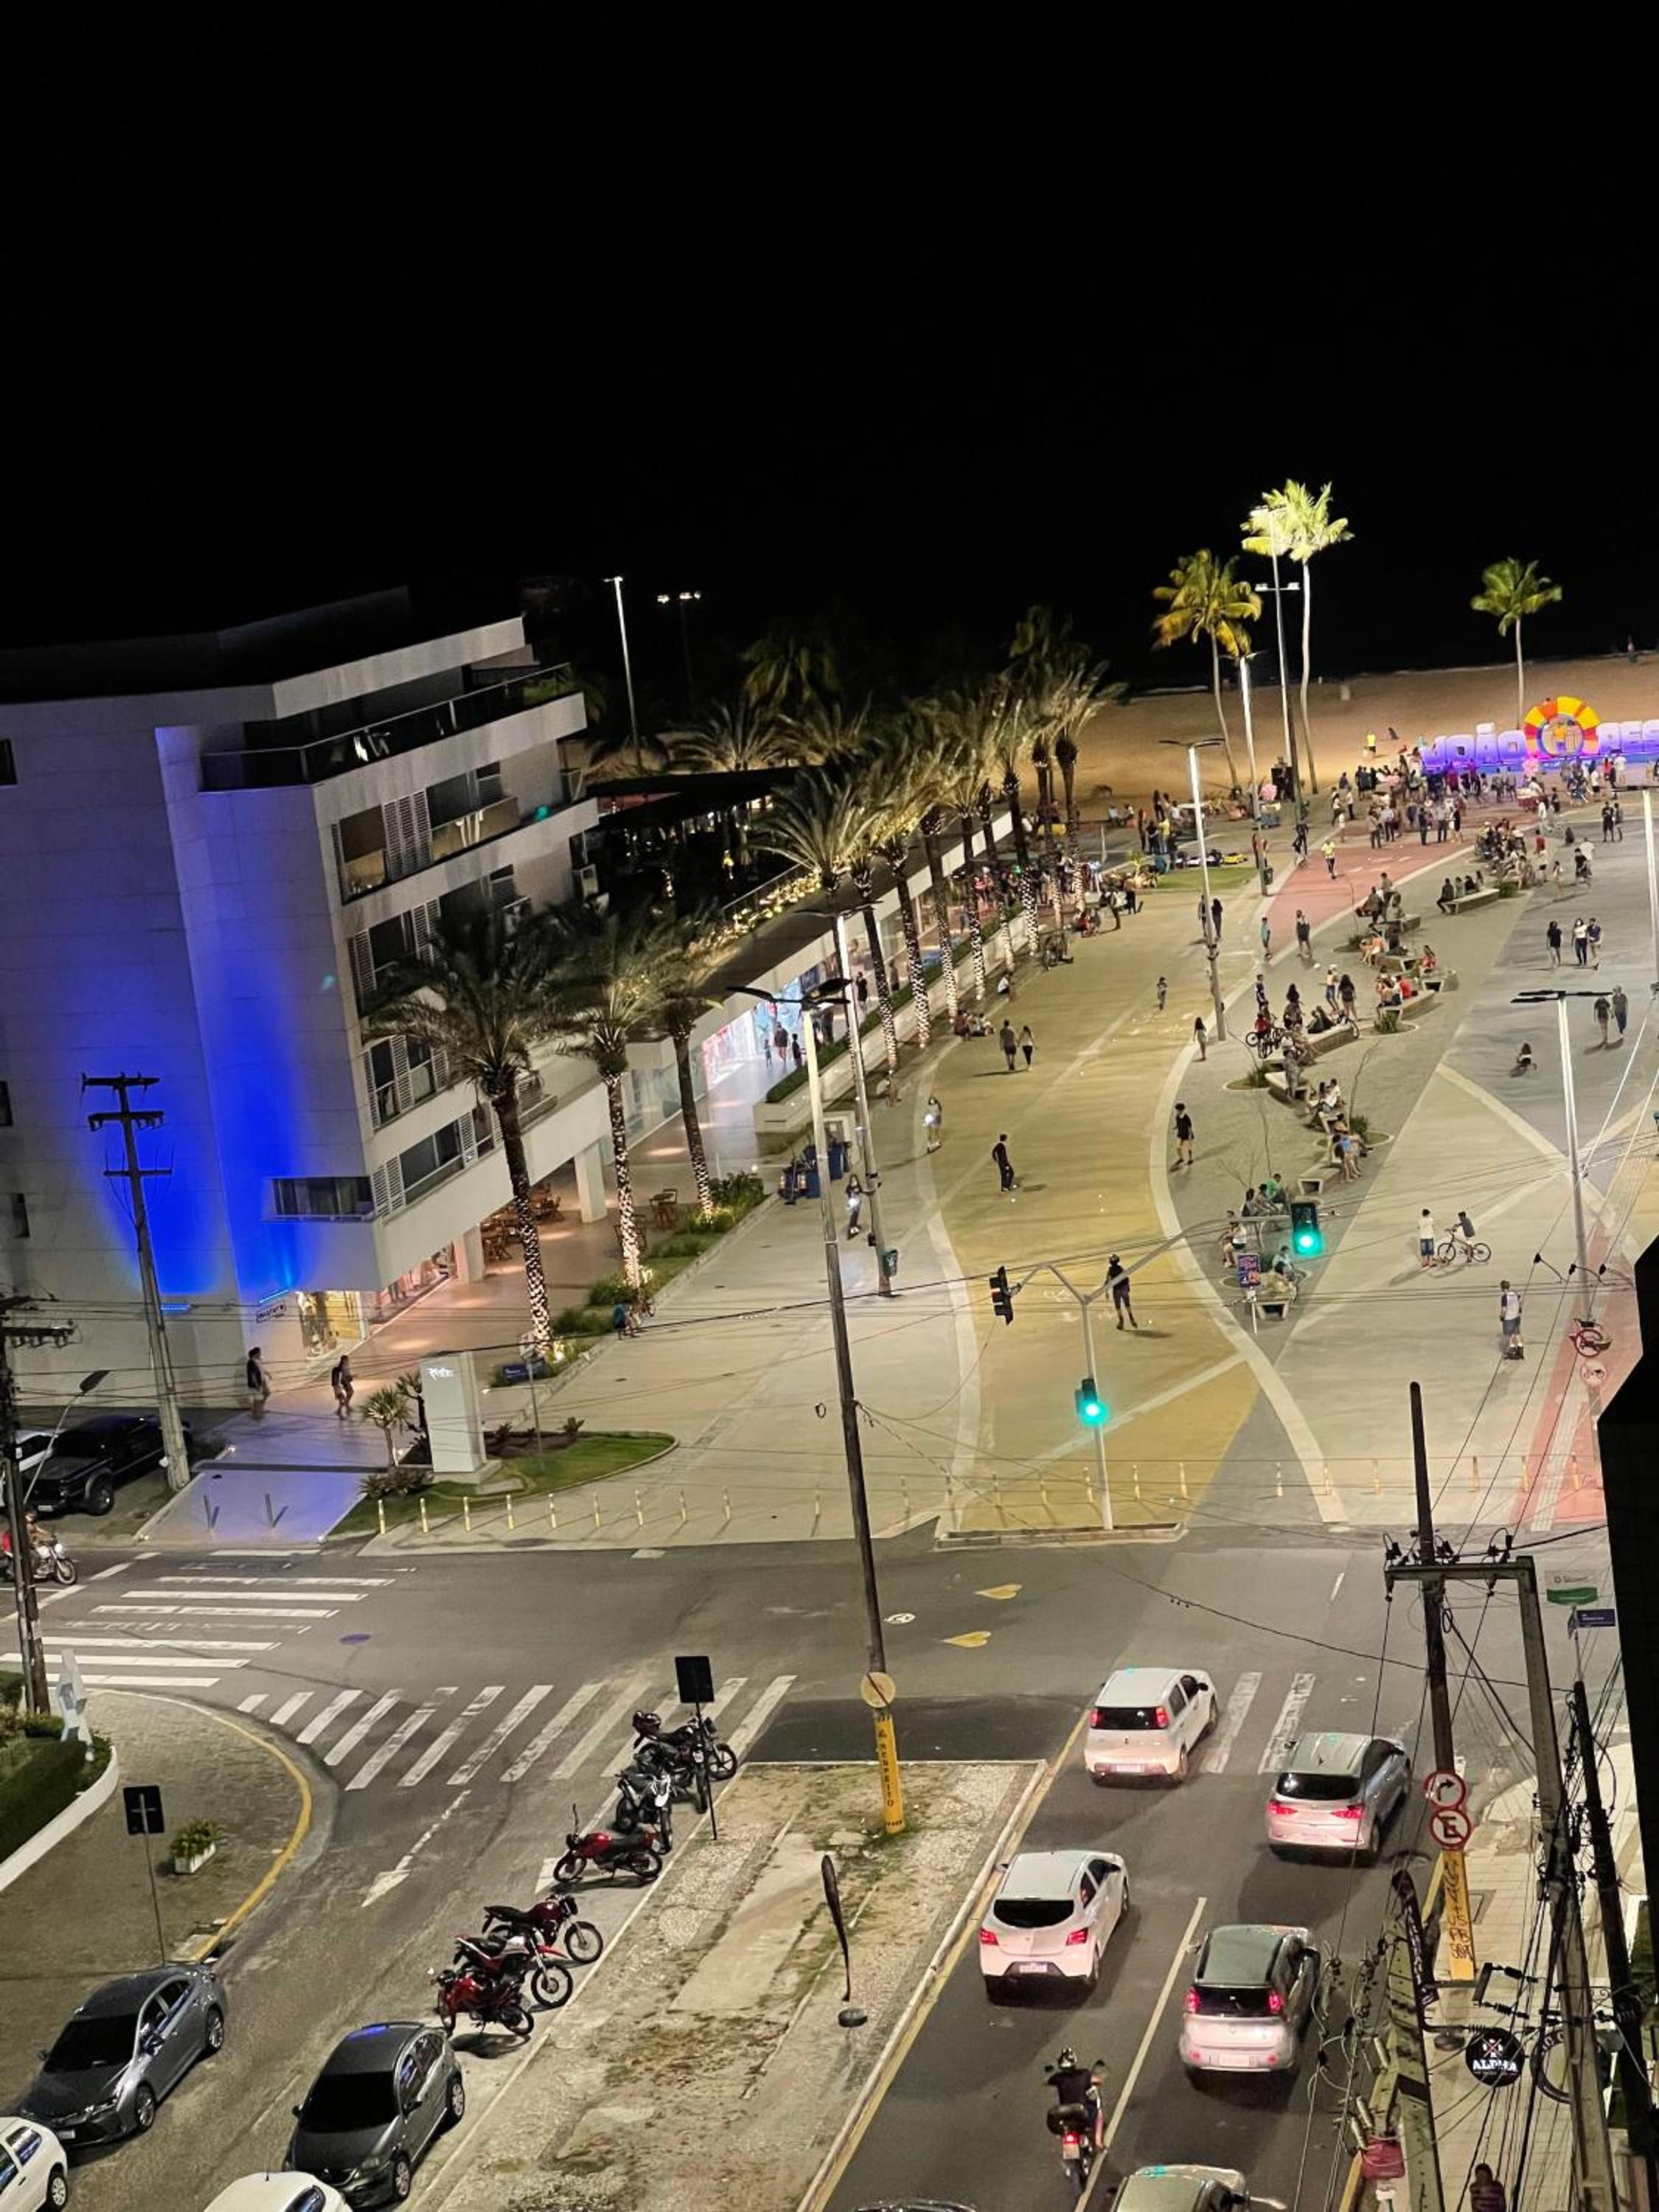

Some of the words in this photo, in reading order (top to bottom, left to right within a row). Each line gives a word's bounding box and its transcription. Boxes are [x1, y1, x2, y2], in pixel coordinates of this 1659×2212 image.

[1420, 723, 1526, 765] JOÃO
[1443, 1816, 1459, 1837] E
[1472, 2059, 1518, 2072] ALPHA
